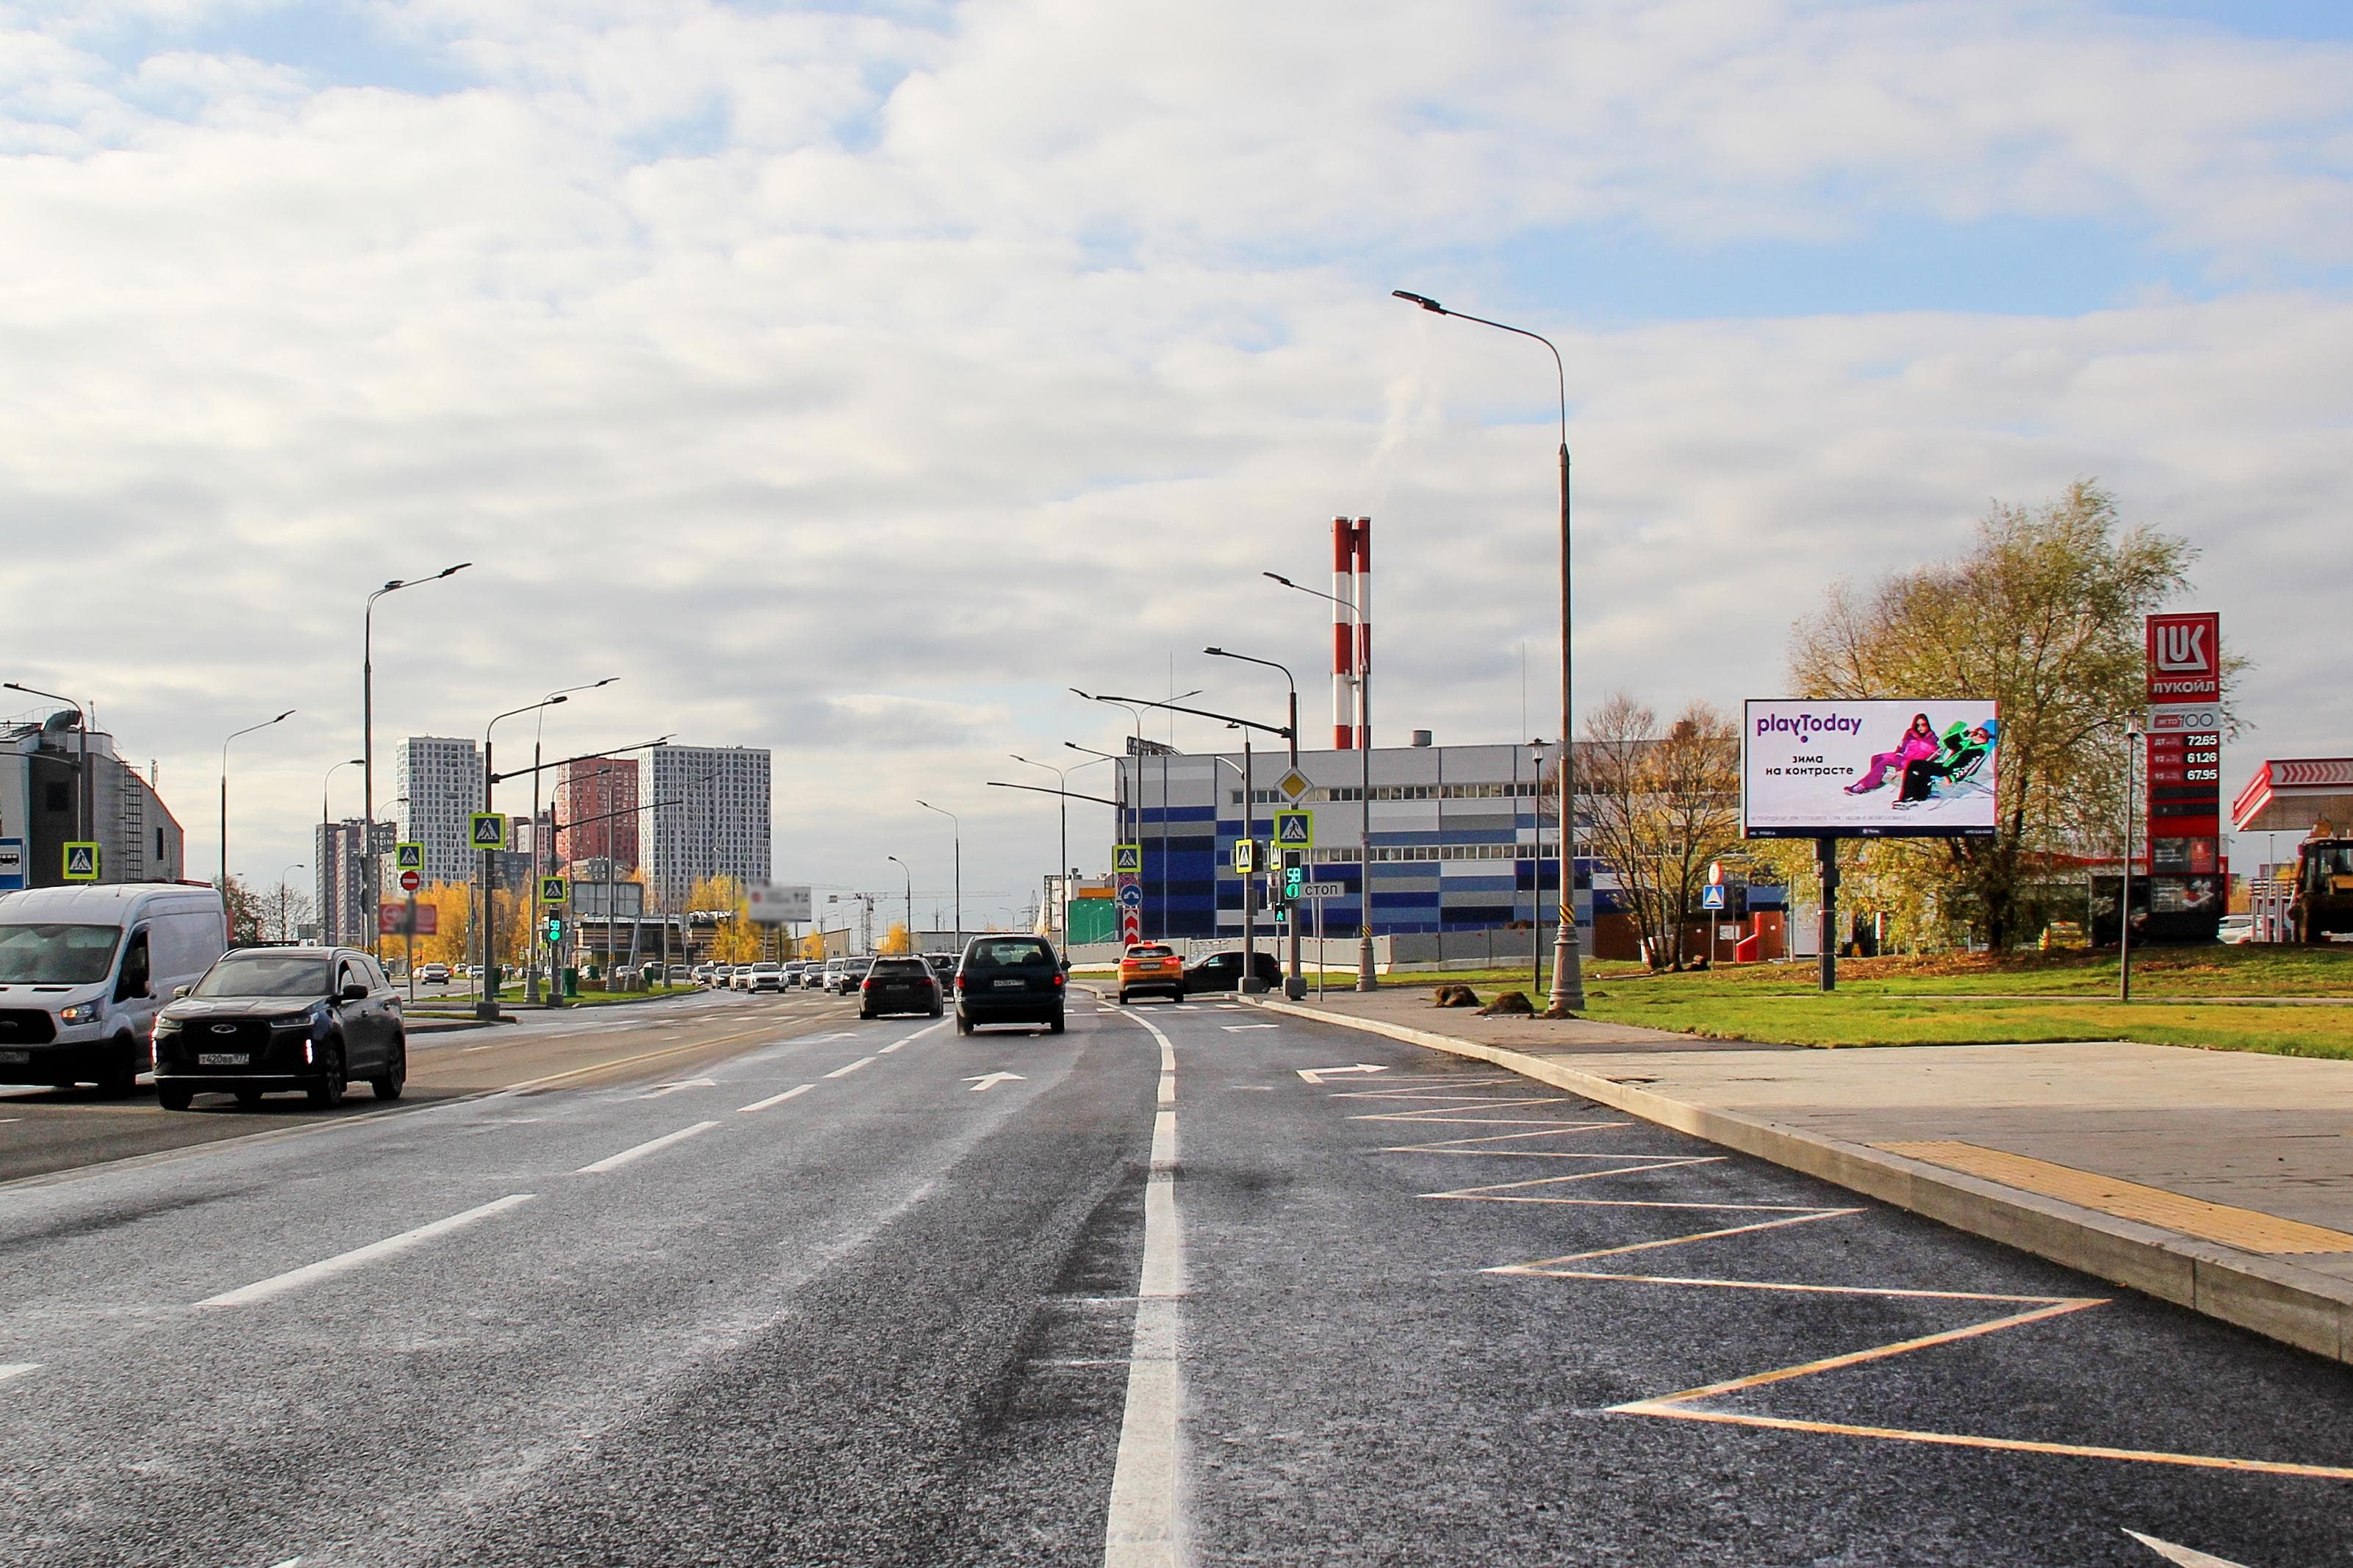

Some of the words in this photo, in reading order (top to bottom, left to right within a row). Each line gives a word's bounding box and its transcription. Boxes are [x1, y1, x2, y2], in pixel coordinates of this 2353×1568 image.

[2153, 679, 2216, 693] ЛУКОЙЛ
[1757, 713, 1862, 737] playToday
[1792, 755, 1823, 763] зима
[1766, 767, 1781, 775] на
[1786, 766, 1854, 777] контрасте
[1305, 885, 1337, 895] СТОП
